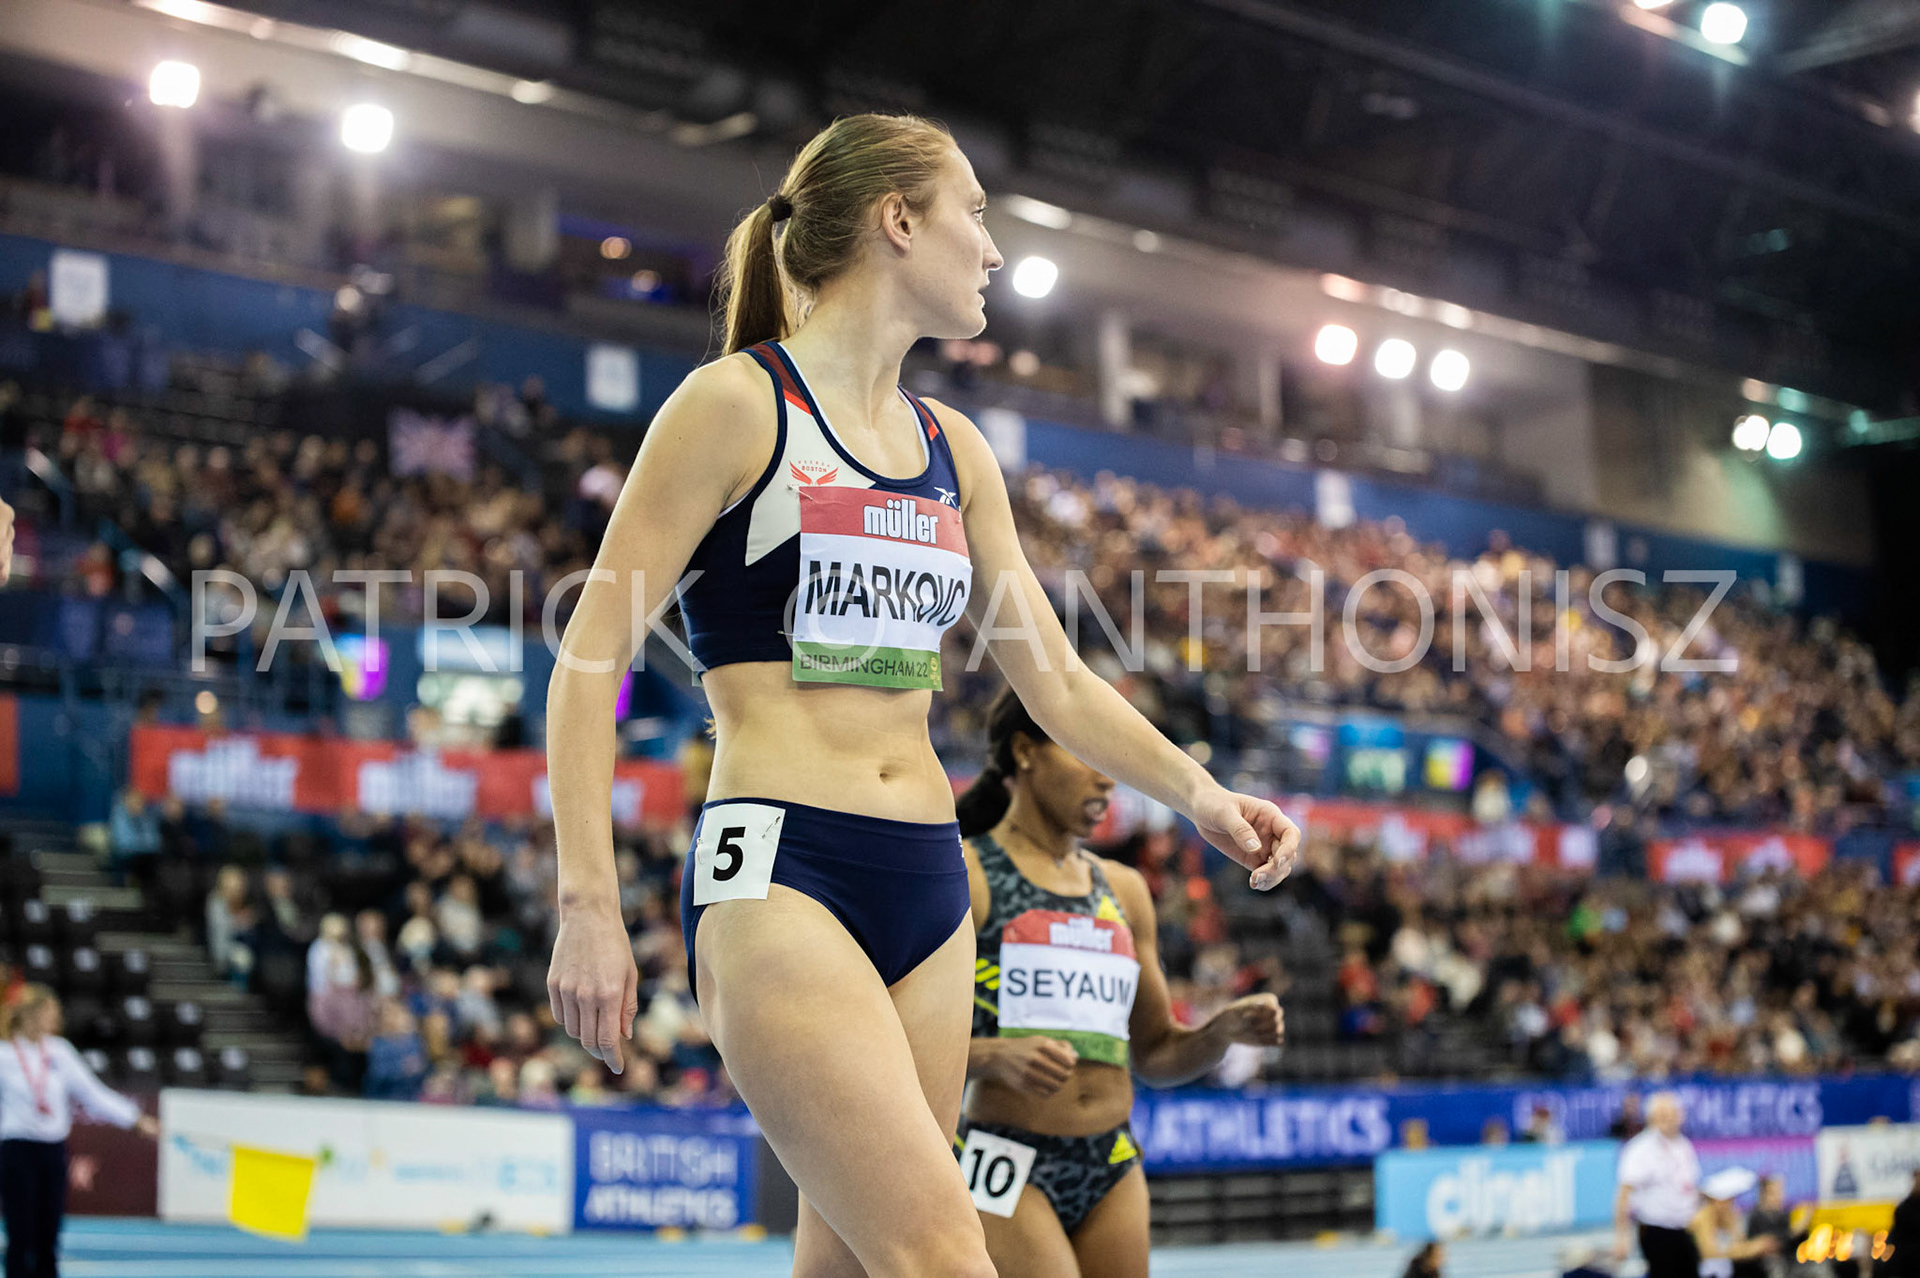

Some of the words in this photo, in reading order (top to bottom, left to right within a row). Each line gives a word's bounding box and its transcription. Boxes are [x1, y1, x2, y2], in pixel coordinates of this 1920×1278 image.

[801, 465, 827, 473] BOSTON
[863, 498, 939, 545] müller
[800, 653, 915, 677] BIRMINGHAM
[916, 662, 928, 677] 22
[712, 826, 746, 882] 5
[1147, 1099, 1389, 1161] ATHLETICS
[969, 1148, 1015, 1198] 10
